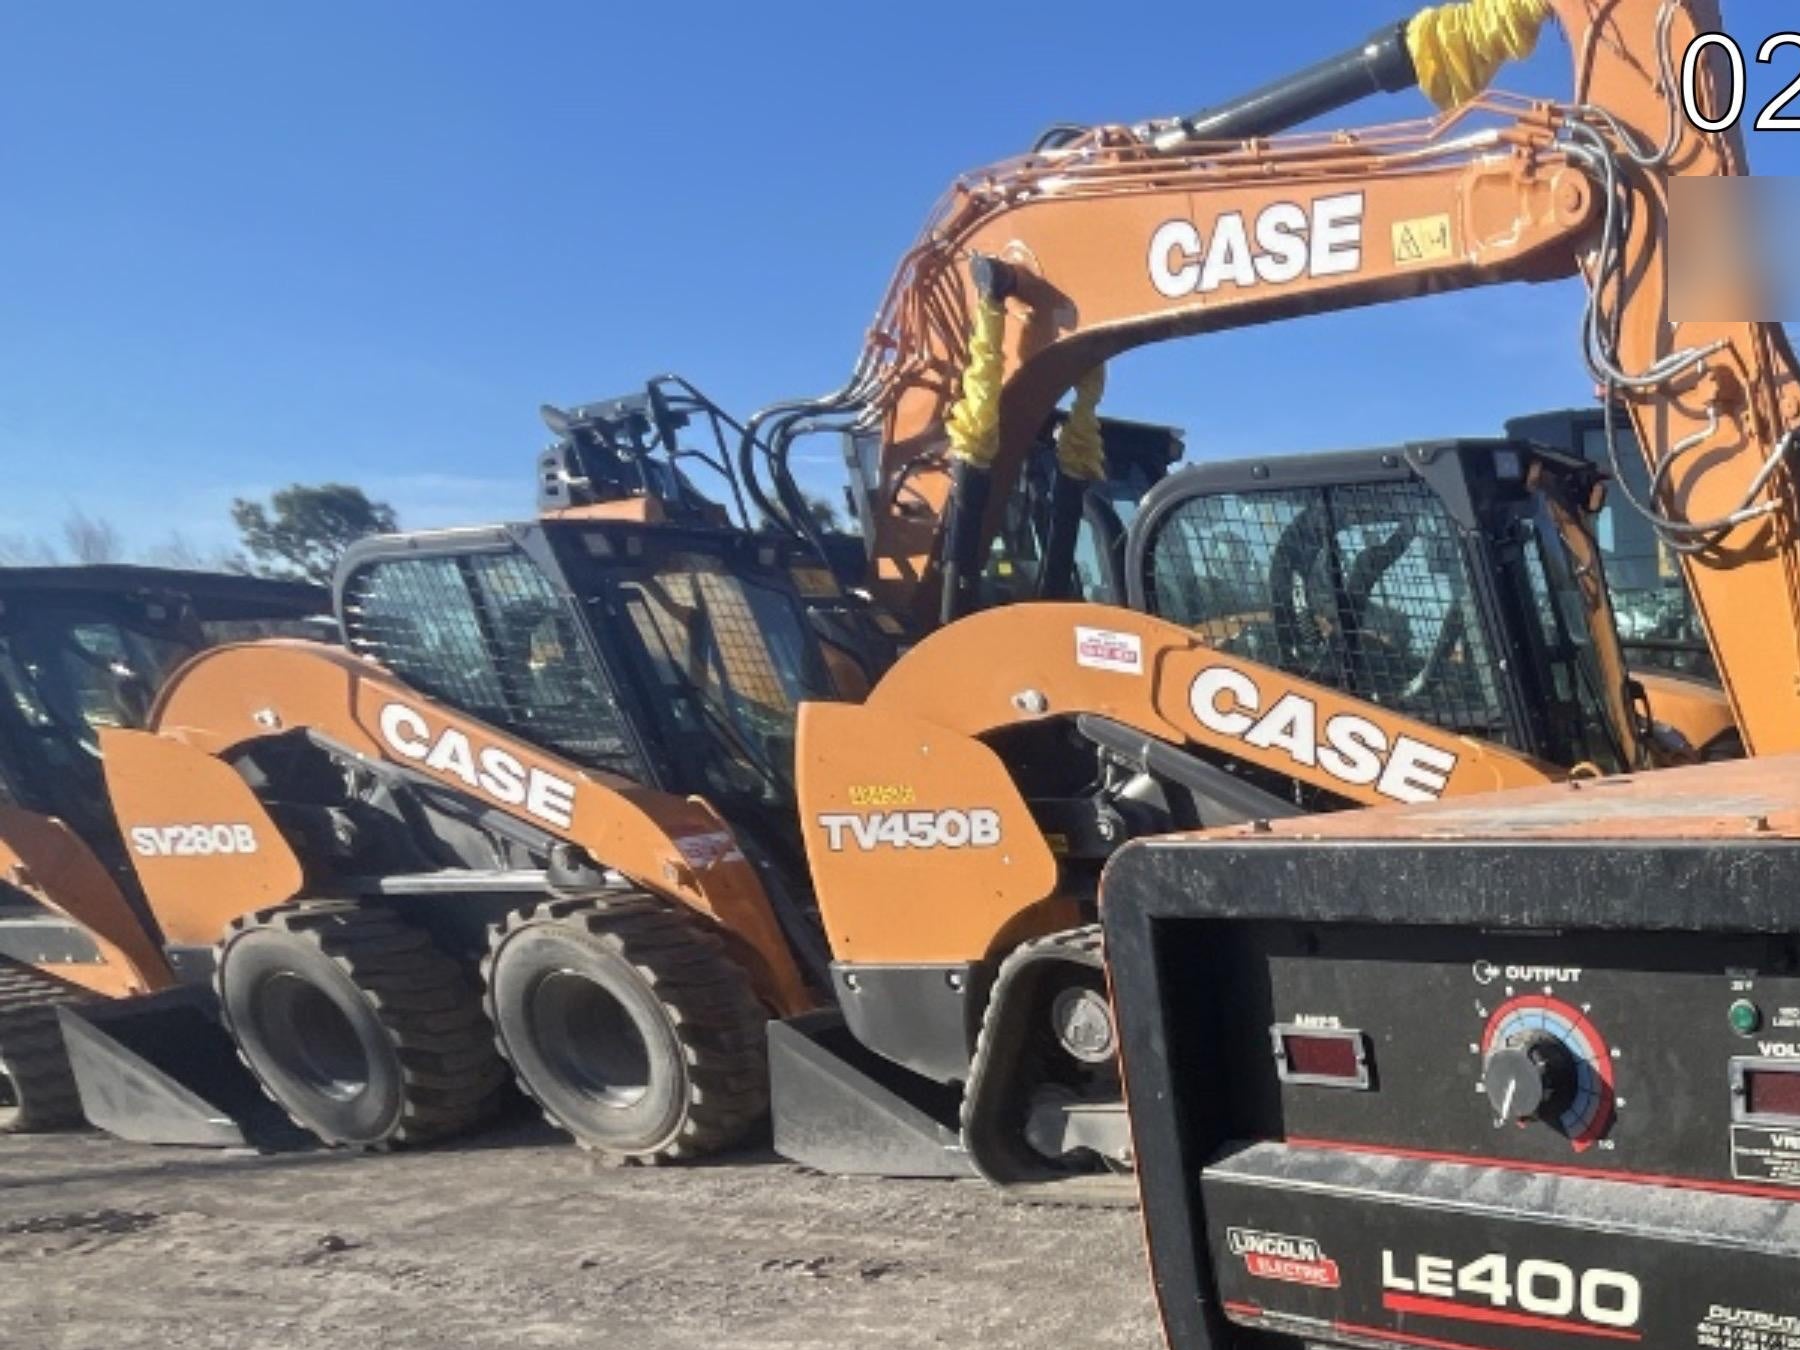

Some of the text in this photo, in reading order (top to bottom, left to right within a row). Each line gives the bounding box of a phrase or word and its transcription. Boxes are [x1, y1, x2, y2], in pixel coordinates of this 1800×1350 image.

[1147, 191, 1364, 297] CASE
[1188, 665, 1458, 803] CASE
[379, 702, 577, 831] CASE
[130, 823, 258, 857] SV280B
[817, 808, 1001, 852] TV450B
[1504, 965, 1582, 982] OUTPUT
[1229, 1232, 1317, 1262] LINCOLN
[1382, 1249, 1642, 1328] LE400
